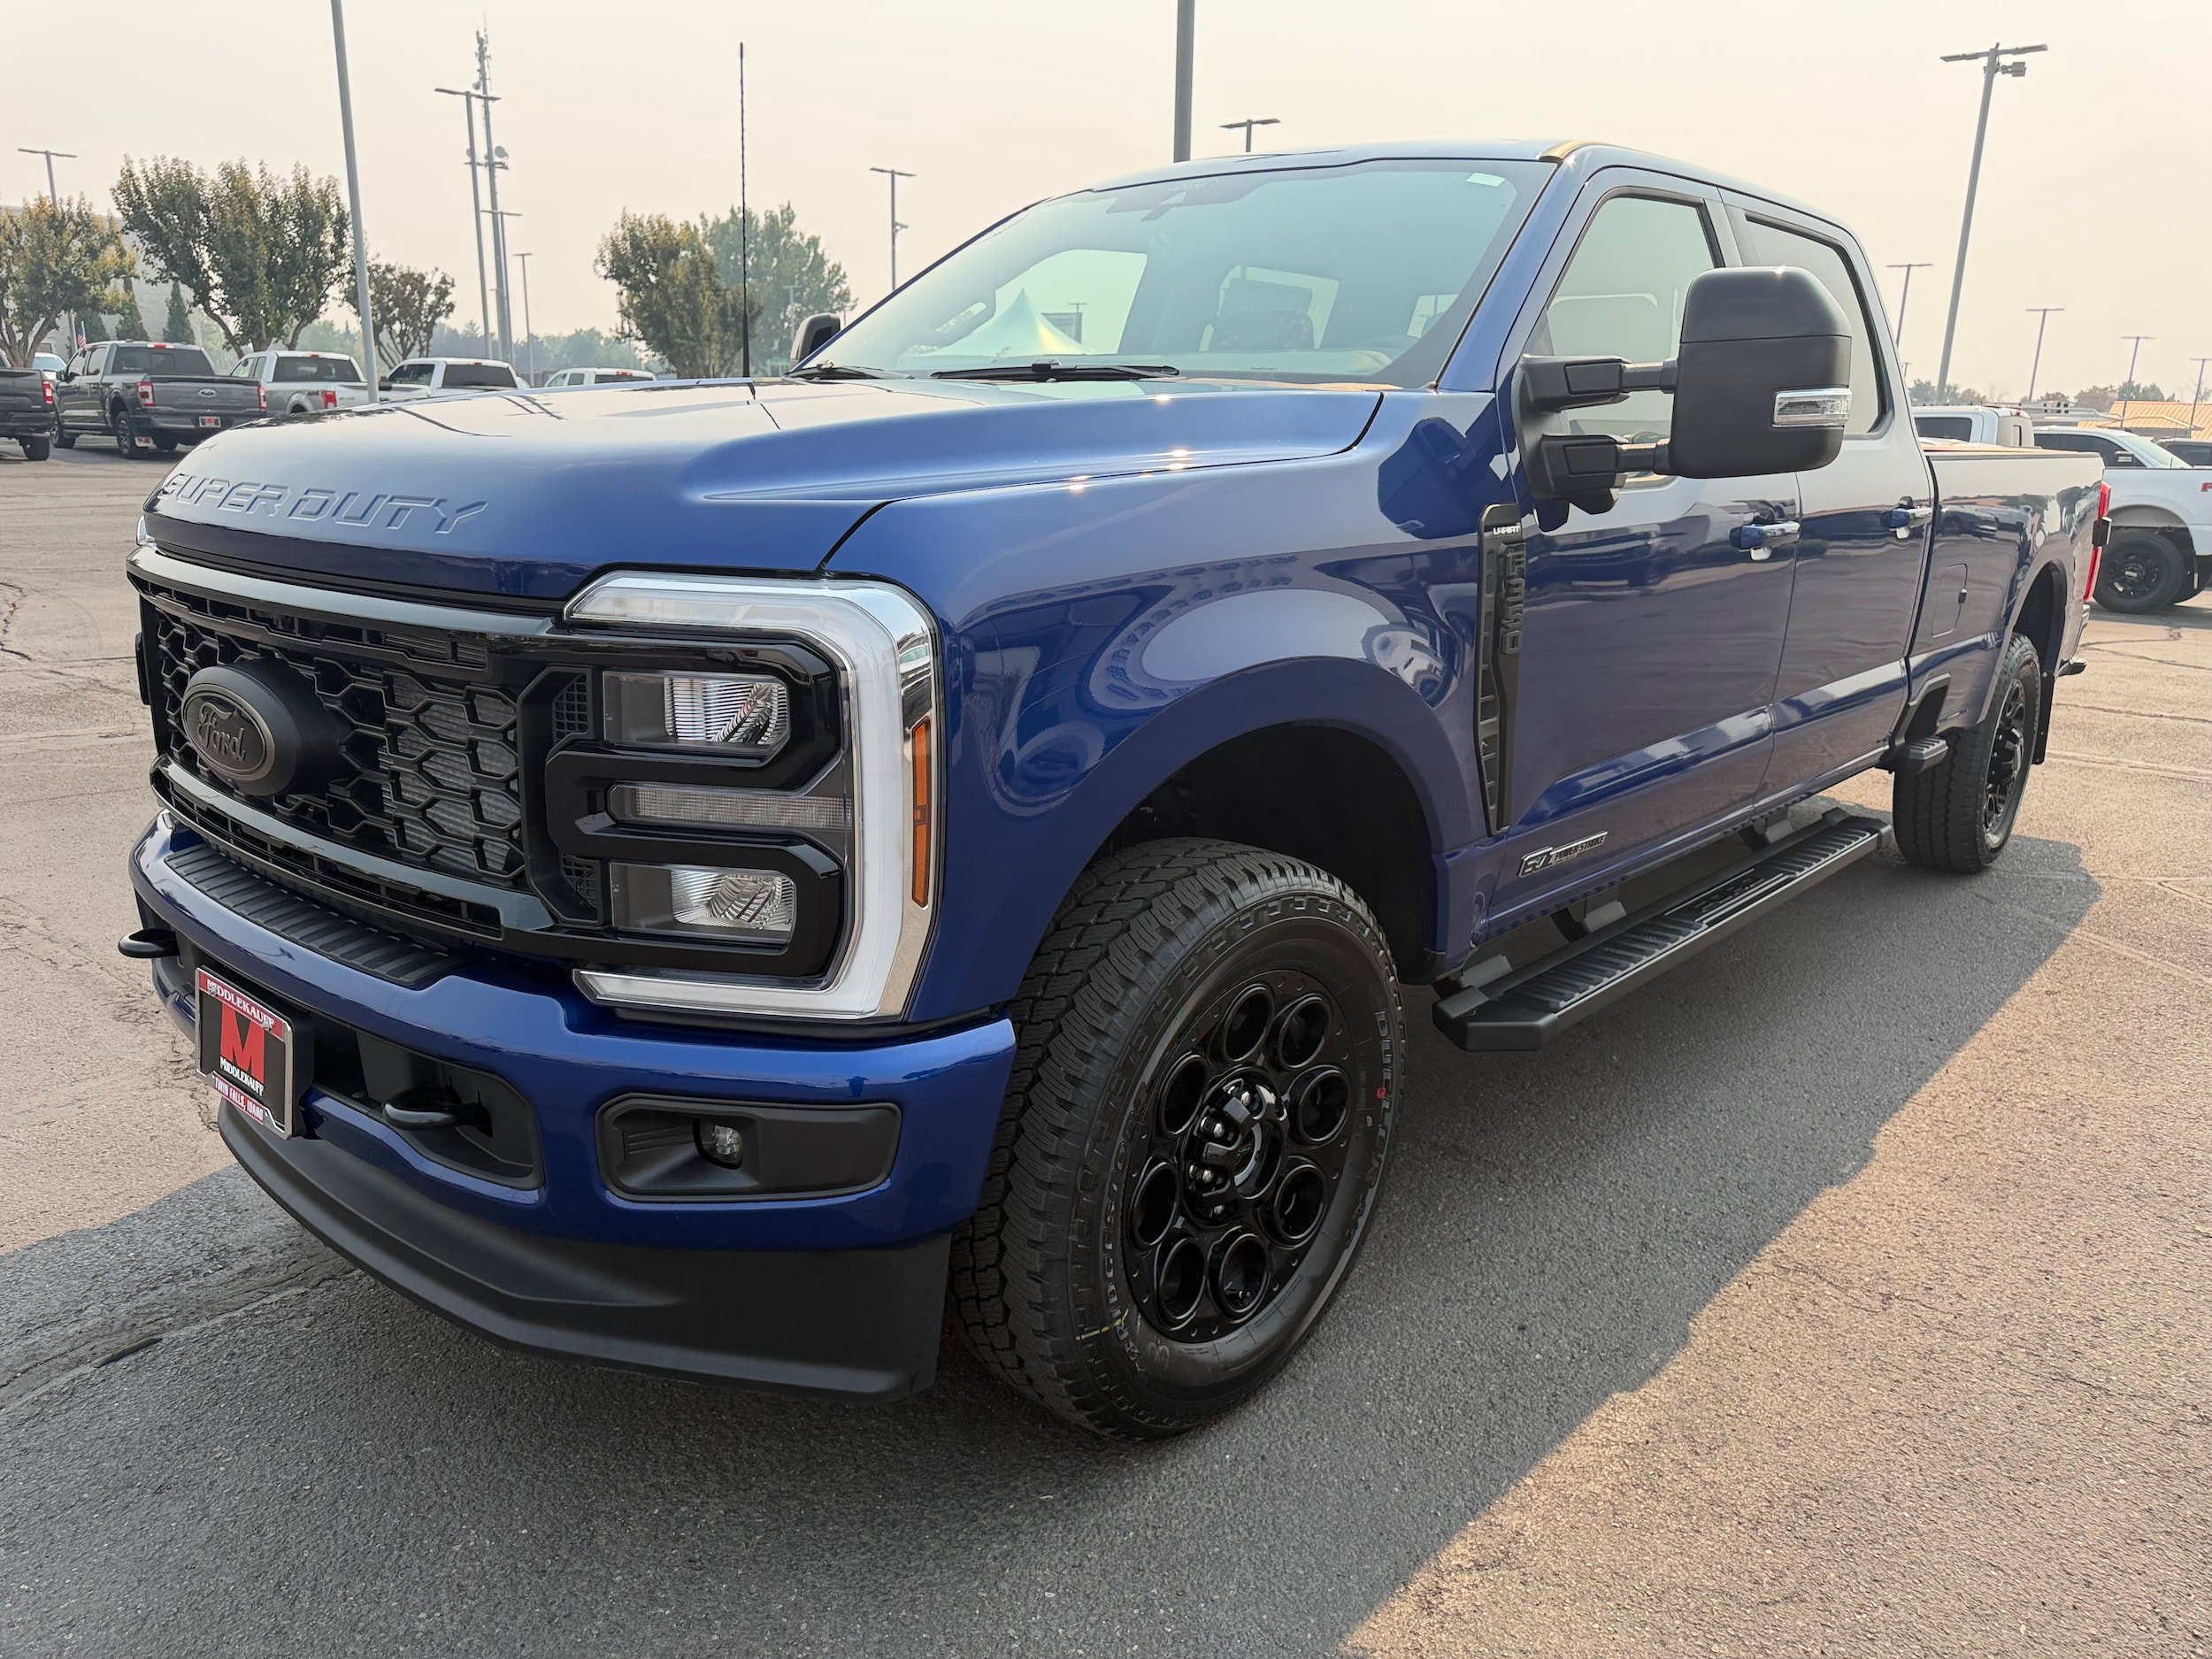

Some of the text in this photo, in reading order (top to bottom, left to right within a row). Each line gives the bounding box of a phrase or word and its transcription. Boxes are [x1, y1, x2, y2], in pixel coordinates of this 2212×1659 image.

[157, 472, 488, 534] SUPER DUTY
[197, 702, 246, 763] Ford
[207, 978, 275, 1029] MDDLEKAUFF
[219, 1003, 265, 1085] M
[215, 1076, 230, 1097] TWIN
[229, 1087, 247, 1111] FALLS,
[219, 1056, 265, 1096] MIDDLEKAUFF
